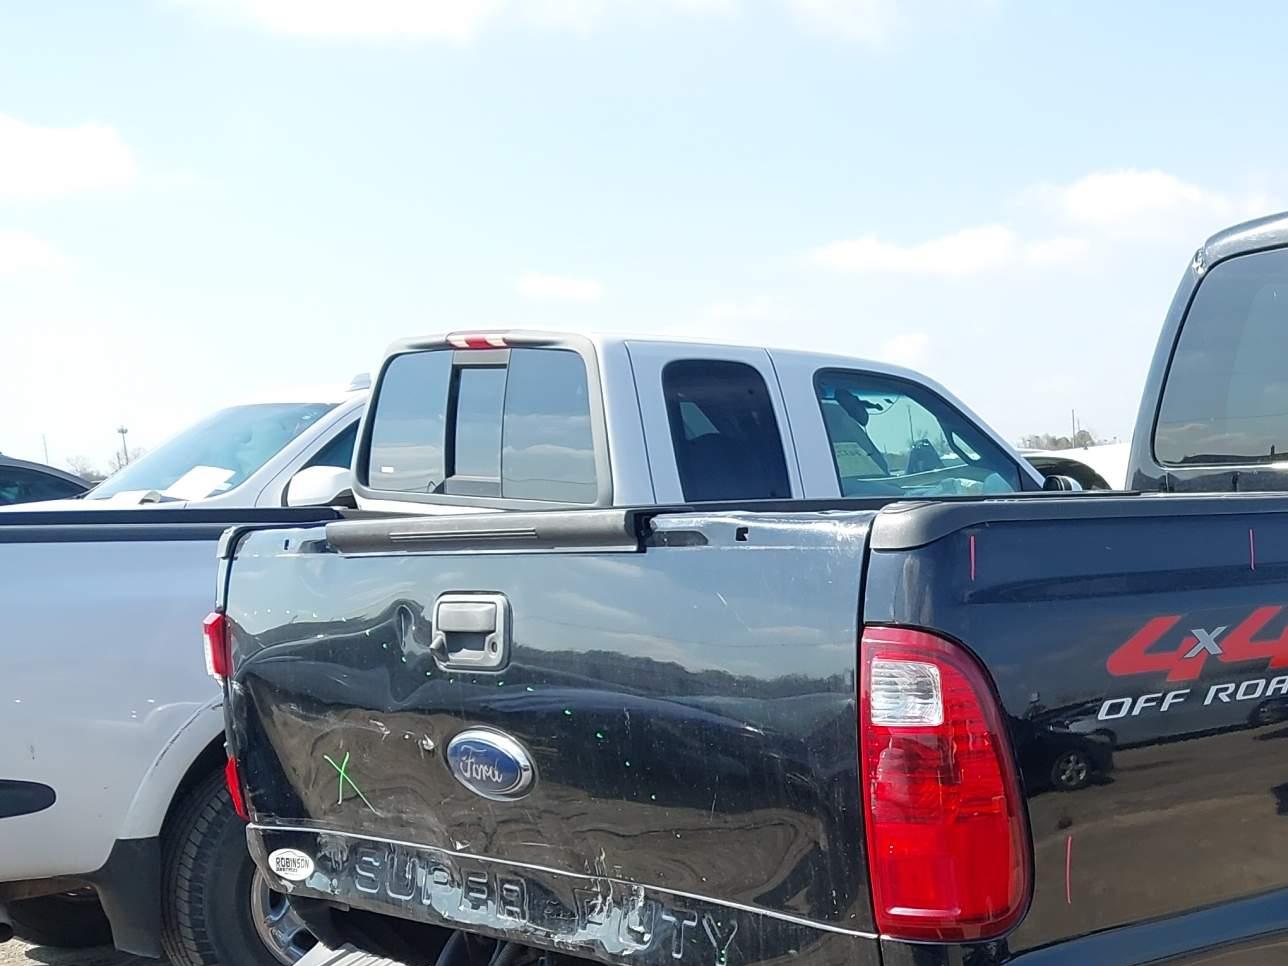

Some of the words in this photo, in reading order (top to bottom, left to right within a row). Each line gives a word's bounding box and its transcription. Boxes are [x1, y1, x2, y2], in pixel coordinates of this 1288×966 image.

[1097, 688, 1191, 720] OFF
[460, 744, 503, 783] Ford
[275, 857, 310, 869] ROBINSON
[354, 845, 529, 924] SUPER
